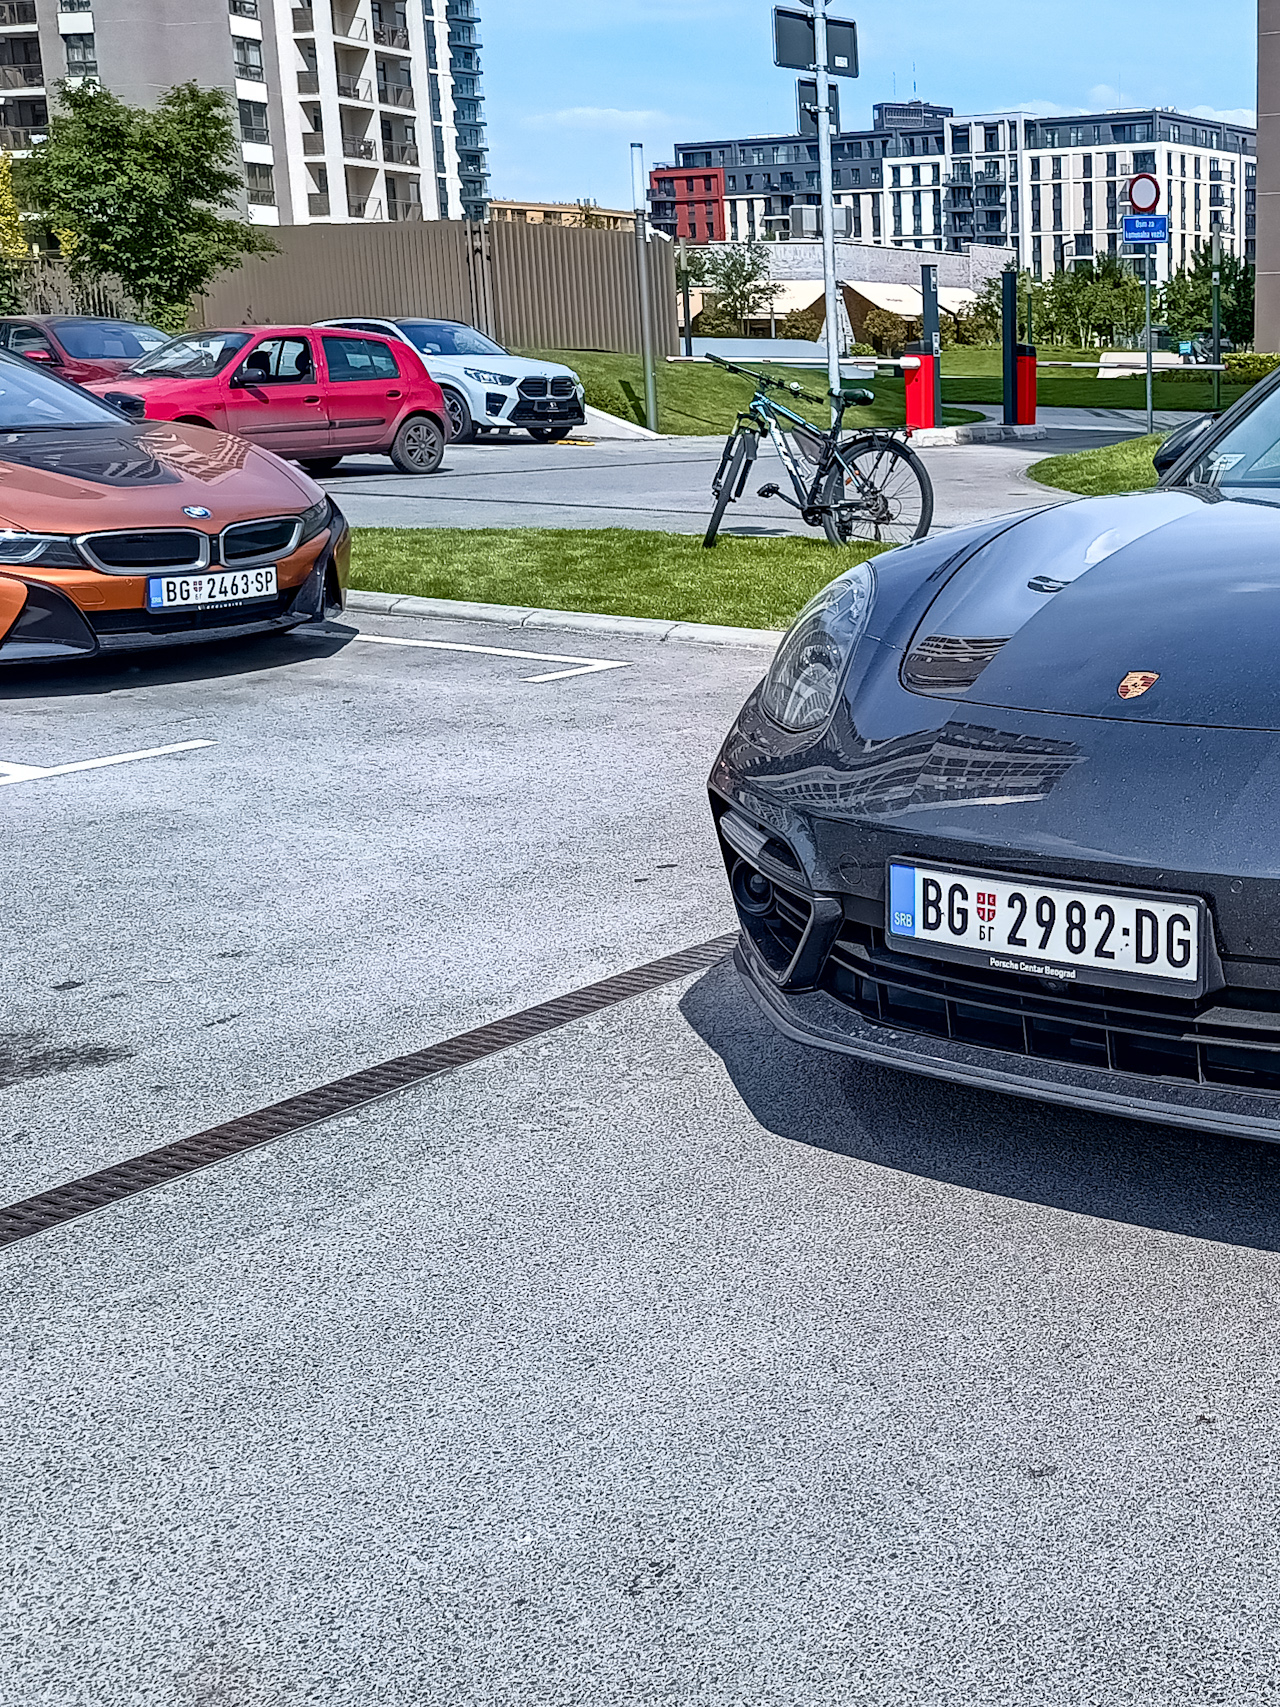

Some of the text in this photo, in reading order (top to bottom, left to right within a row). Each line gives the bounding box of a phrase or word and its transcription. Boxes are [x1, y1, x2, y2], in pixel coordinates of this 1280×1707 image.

[166, 580, 190, 602] BG
[922, 878, 969, 936] BG
[894, 911, 913, 928] SRB
[979, 925, 995, 942] БГ
[989, 957, 1076, 979] Porsche Centar Beograd
